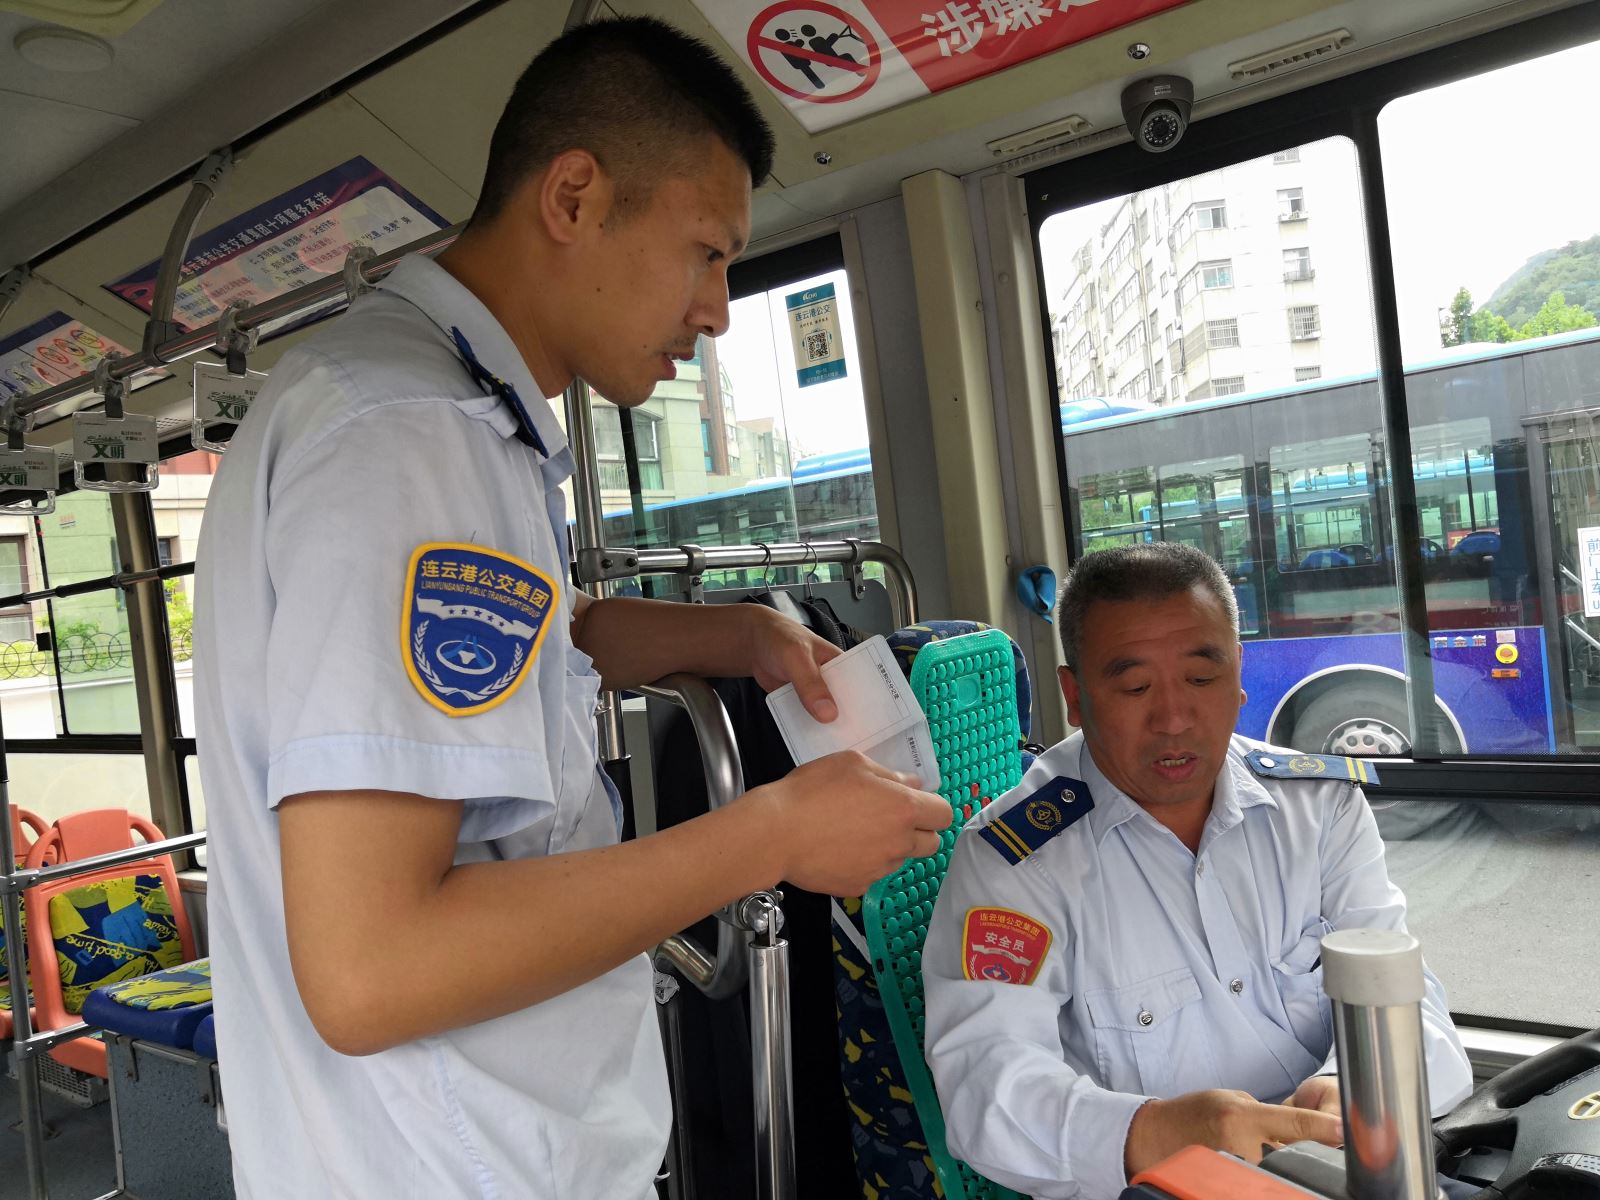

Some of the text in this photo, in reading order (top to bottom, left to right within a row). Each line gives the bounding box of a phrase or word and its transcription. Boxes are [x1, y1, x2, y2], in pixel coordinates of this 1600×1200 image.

[920, 0, 1100, 57] 涉嫌
[795, 304, 832, 322] 连云港公交
[421, 559, 550, 609] 连云港公交集团
[421, 580, 541, 619] LIANYUNGANG PUBLIC TRANSPORT GROUP
[980, 912, 1040, 937] 连云港公交集团
[984, 931, 1025, 953] 安全员
